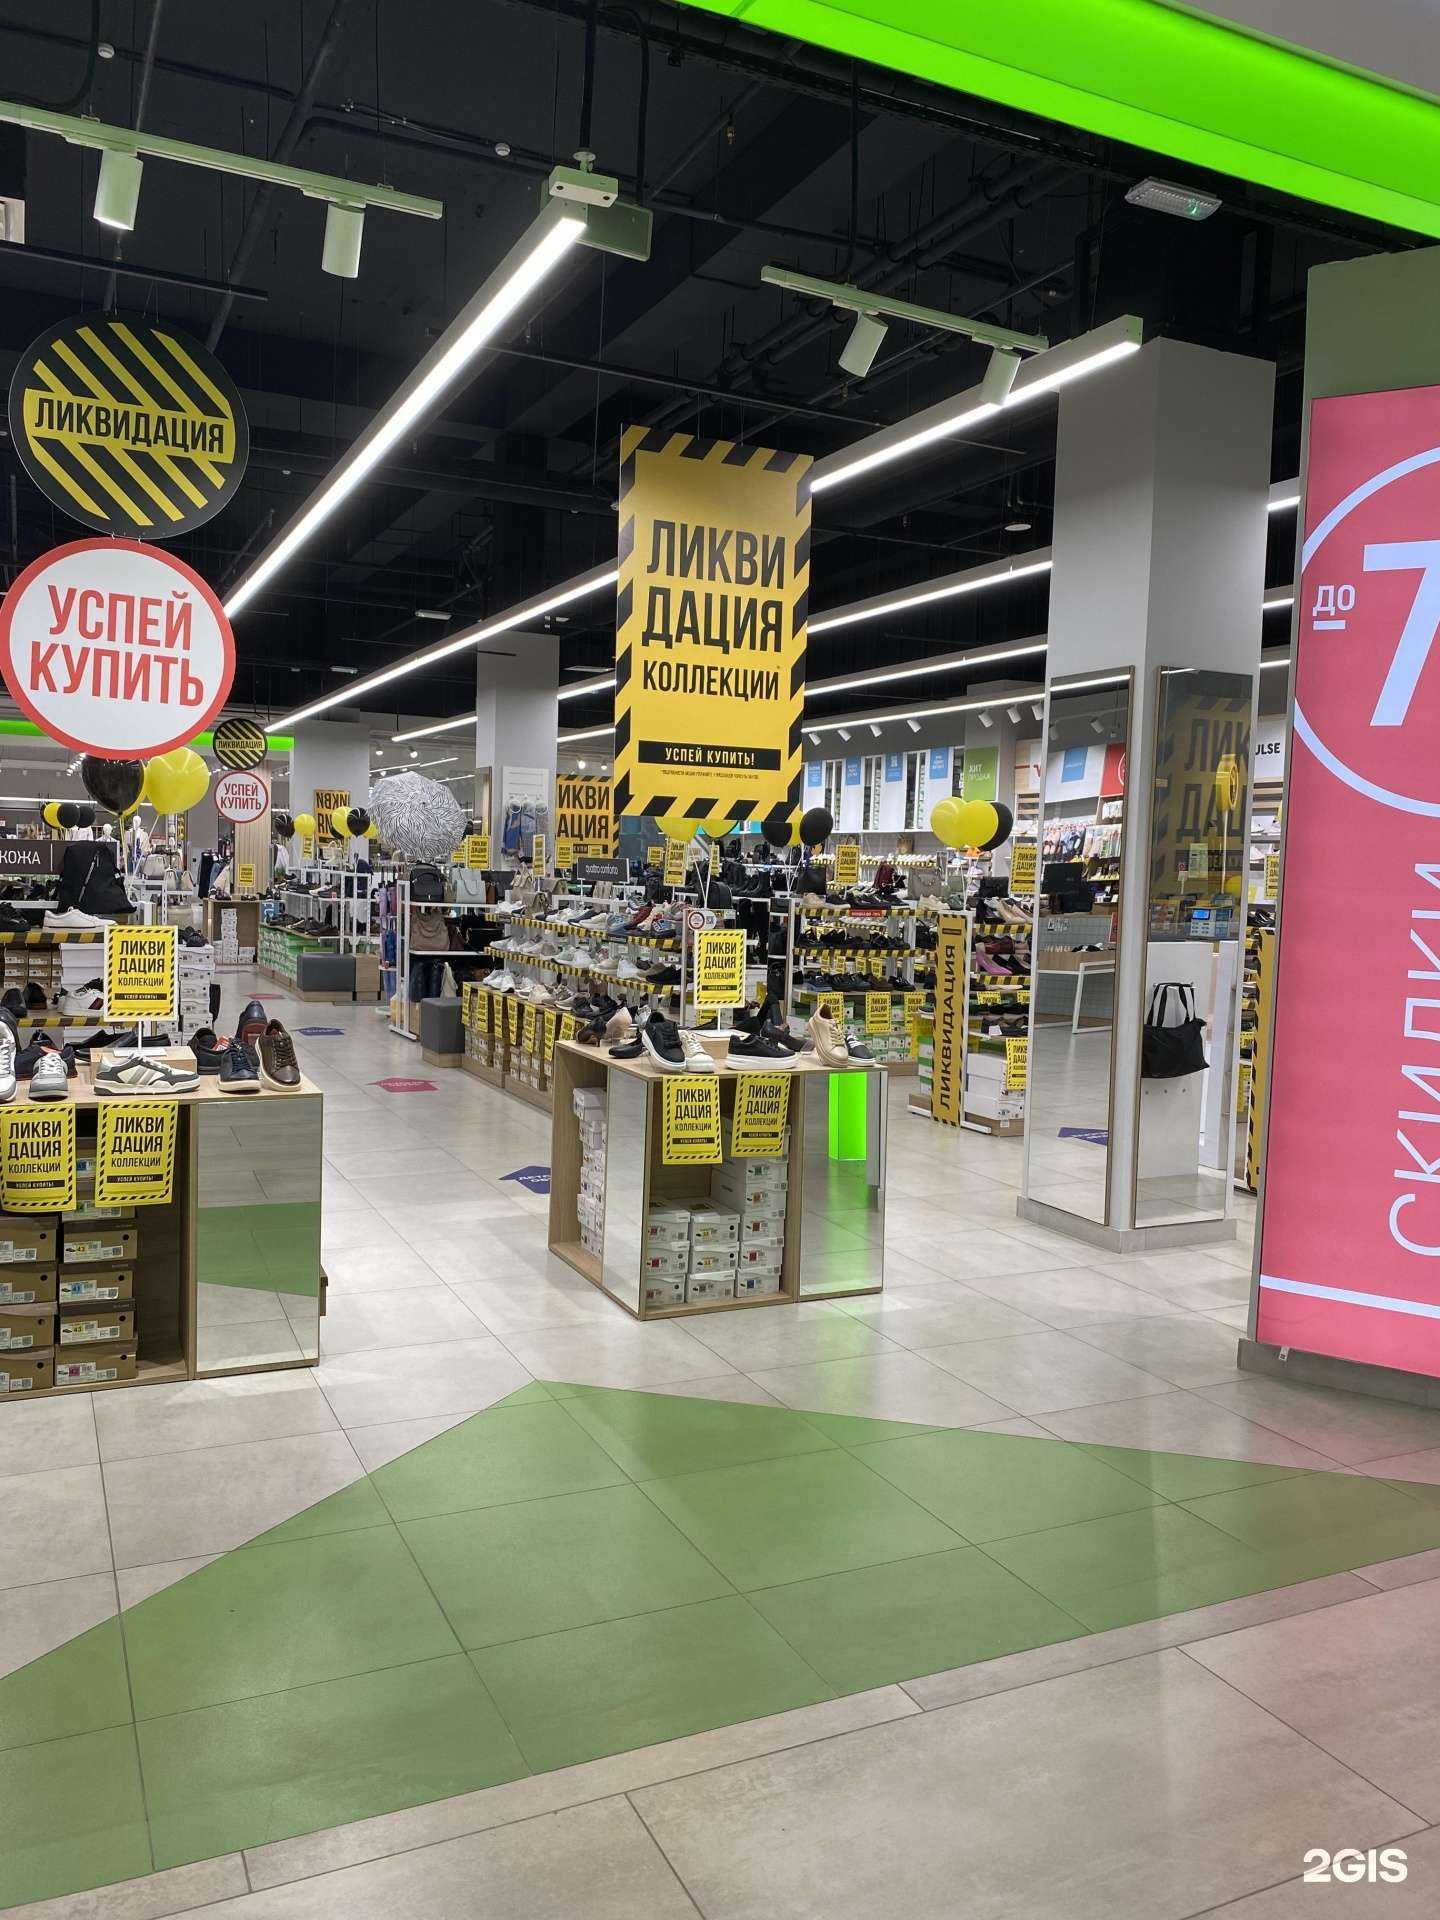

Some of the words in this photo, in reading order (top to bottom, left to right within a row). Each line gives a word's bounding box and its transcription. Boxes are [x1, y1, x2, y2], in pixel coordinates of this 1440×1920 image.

[35, 397, 225, 454] ЛИКВИДАЦИЯ
[646, 519, 786, 590] ЛИКВИ
[1312, 584, 1356, 616] ДО
[48, 584, 193, 651] УСПЕЙ
[641, 586, 783, 654] ДАЦИЯ
[30, 641, 205, 707] КУПИТЬ
[217, 740, 263, 749] ЛИКВИДАЦИЯ
[665, 746, 702, 763] УСПЕЙ
[707, 750, 755, 766] КУПИТЬ!
[224, 782, 259, 797] УСПЕЙ
[220, 796, 262, 810] КУПИТЬ
[0, 850, 41, 865] КОЖА
[119, 940, 166, 956] ЛИКВИ
[705, 942, 737, 955] ЛИКВИ
[118, 957, 165, 974] ДАЦИЯ
[704, 956, 736, 970] ДАЦИЯ
[118, 977, 164, 987] КОЛЛЕКЦИИ
[939, 944, 955, 1110] ЛИКВИДАЦИЯ
[675, 1088, 712, 1103] ЛИКВИ
[747, 1084, 781, 1099] ЛИКВИ
[675, 1104, 712, 1120] ДАЦИЯ
[745, 1100, 780, 1116] ДАЦИЯ
[8, 1120, 62, 1139] ЛИКВИ
[113, 1116, 165, 1133] ЛИКВИ
[675, 1122, 712, 1132] КОЛЛЕКЦИИ
[8, 1140, 62, 1160] ДАЦИЯ
[111, 1135, 163, 1154] ДАЦИЯ
[8, 1161, 61, 1174] КОЛЛЕКЦИИ
[111, 1156, 161, 1168] КОЛЛЕКЦИИ
